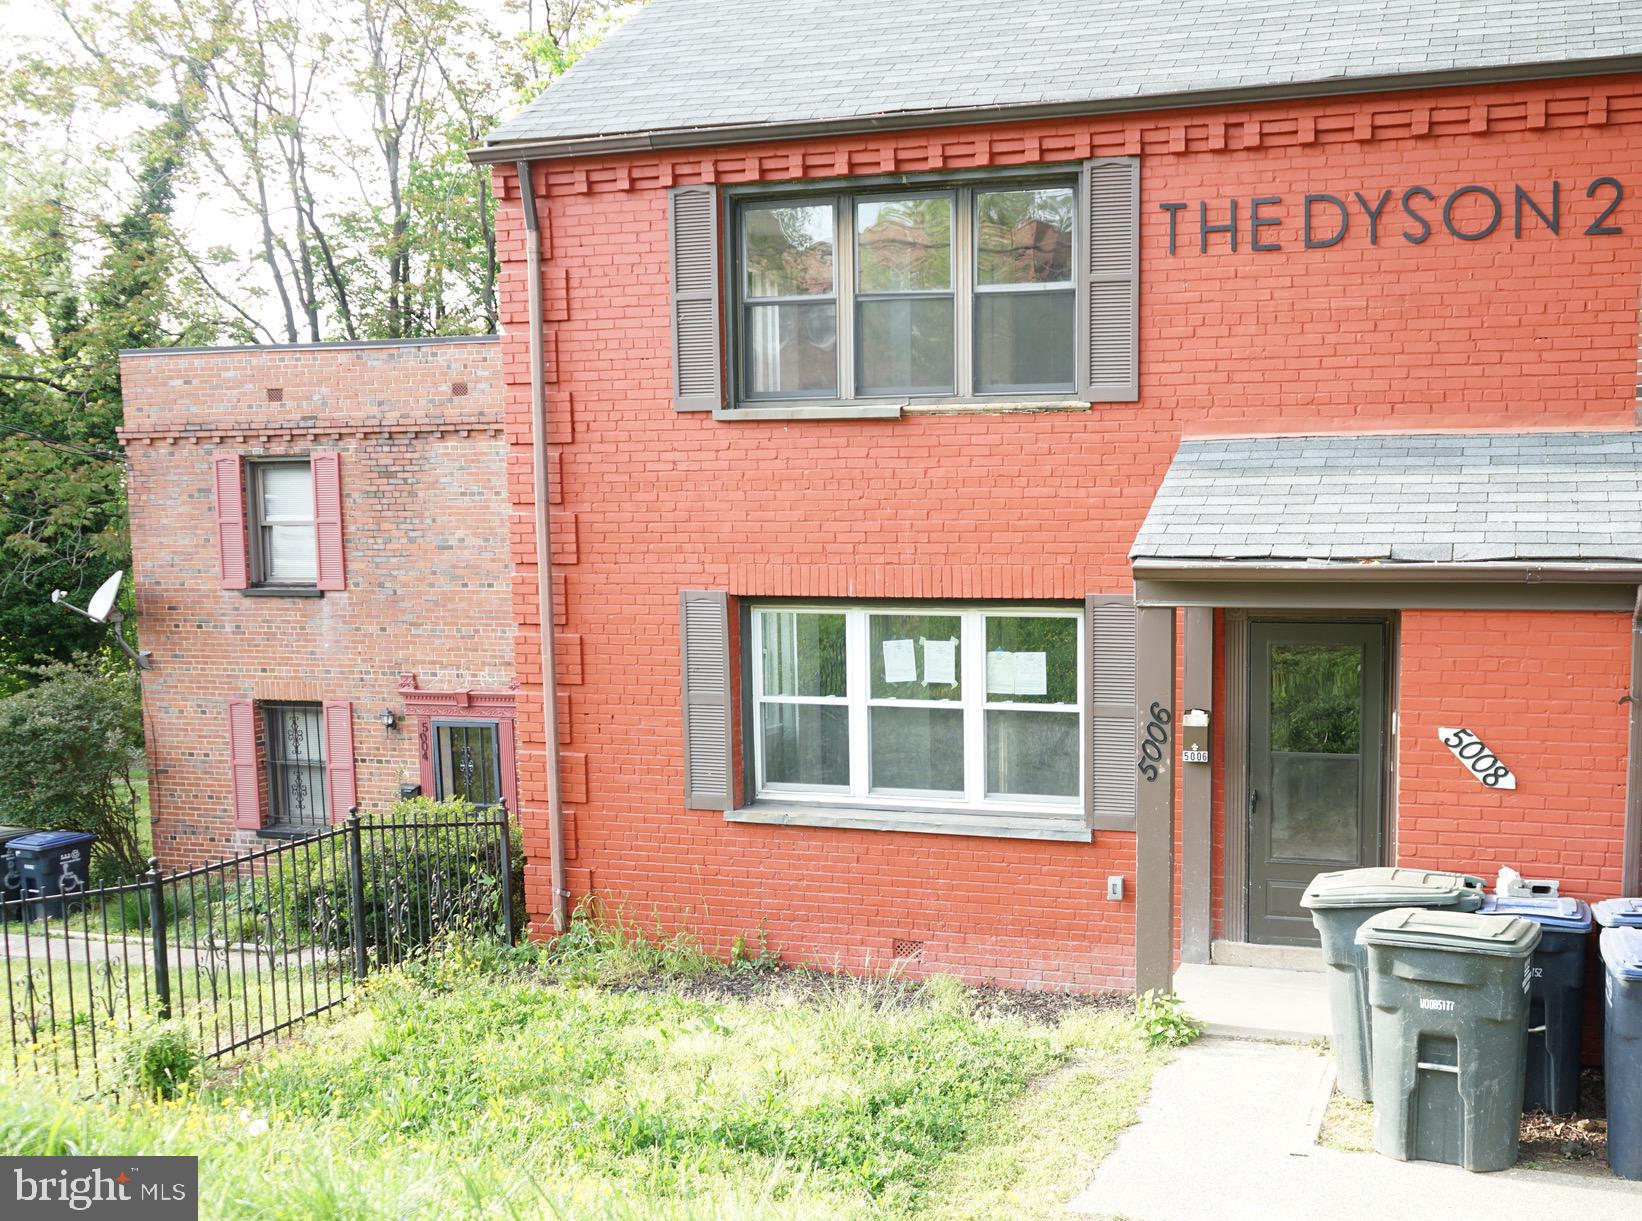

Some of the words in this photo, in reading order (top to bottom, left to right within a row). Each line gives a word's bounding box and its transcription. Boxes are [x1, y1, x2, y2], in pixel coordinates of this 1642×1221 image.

[1159, 196, 1282, 256] THE
[1304, 181, 1560, 249] DYSON
[1583, 176, 1623, 235] 2
[1138, 702, 1171, 783] 5006
[1184, 751, 1207, 761] 5006
[1444, 728, 1509, 787] 5008
